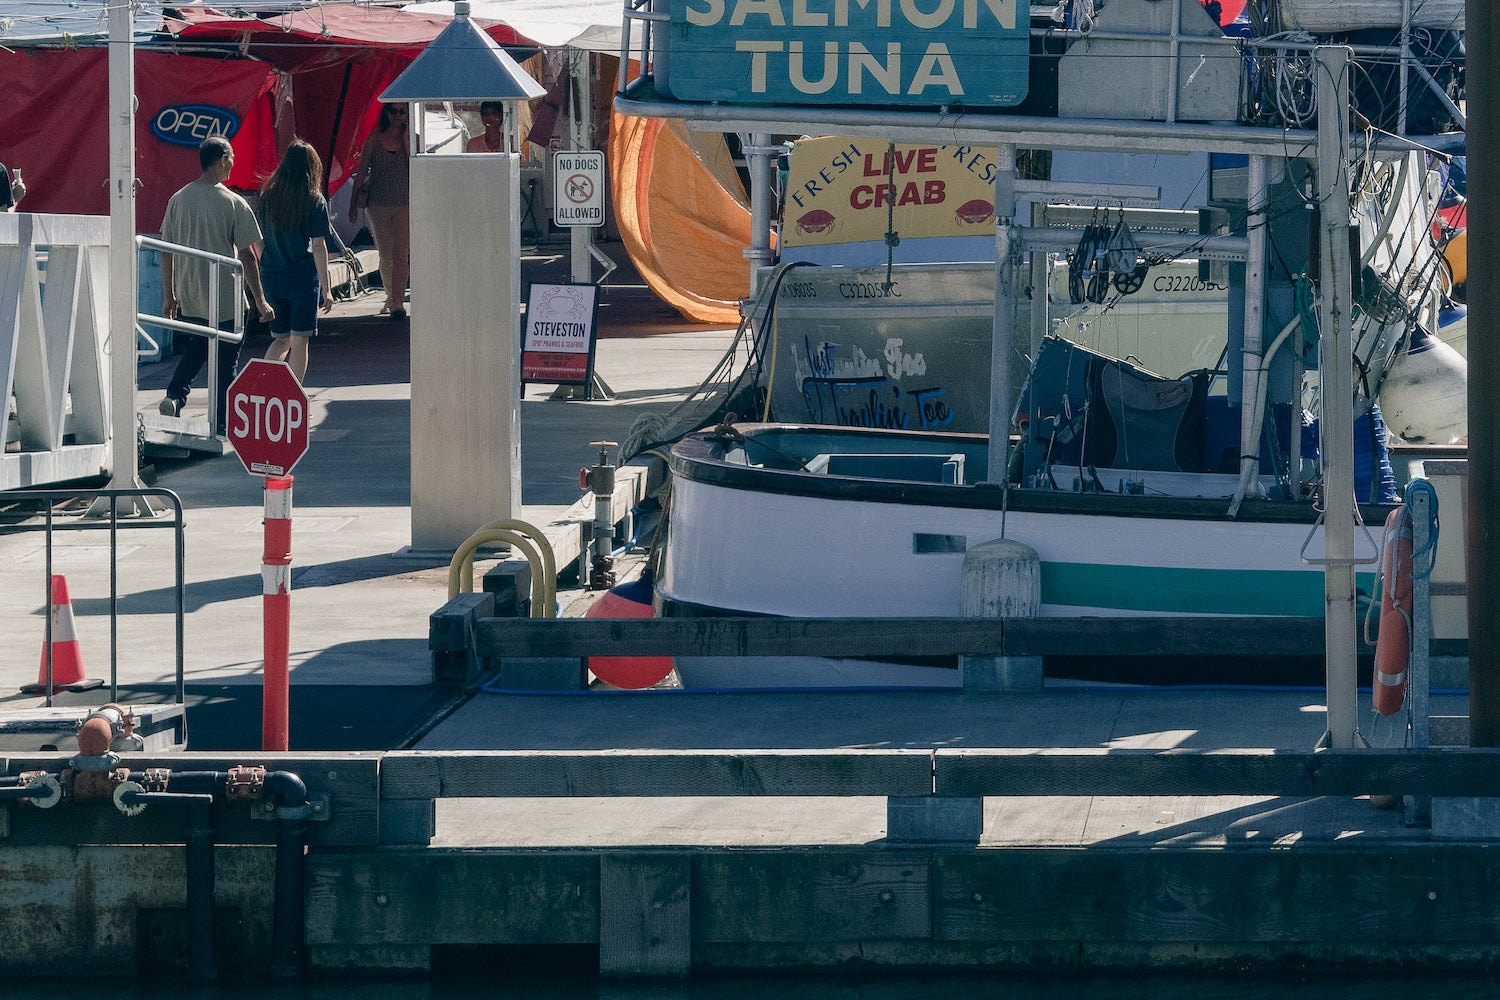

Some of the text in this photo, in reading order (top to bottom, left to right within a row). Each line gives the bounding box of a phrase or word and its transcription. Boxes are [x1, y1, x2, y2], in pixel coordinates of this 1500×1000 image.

[736, 40, 964, 95] TUNA
[157, 109, 231, 139] OPEN
[560, 158, 599, 170] NO DOGS
[791, 143, 862, 208] FRESH
[863, 148, 938, 177] LIVE
[941, 145, 997, 185] RES
[850, 180, 946, 210] CRAB
[559, 207, 600, 219] ALLOWED
[839, 282, 902, 298] C32205C
[533, 321, 586, 337] STEVESTON
[233, 393, 302, 443] STOP
[906, 386, 953, 428] Too
